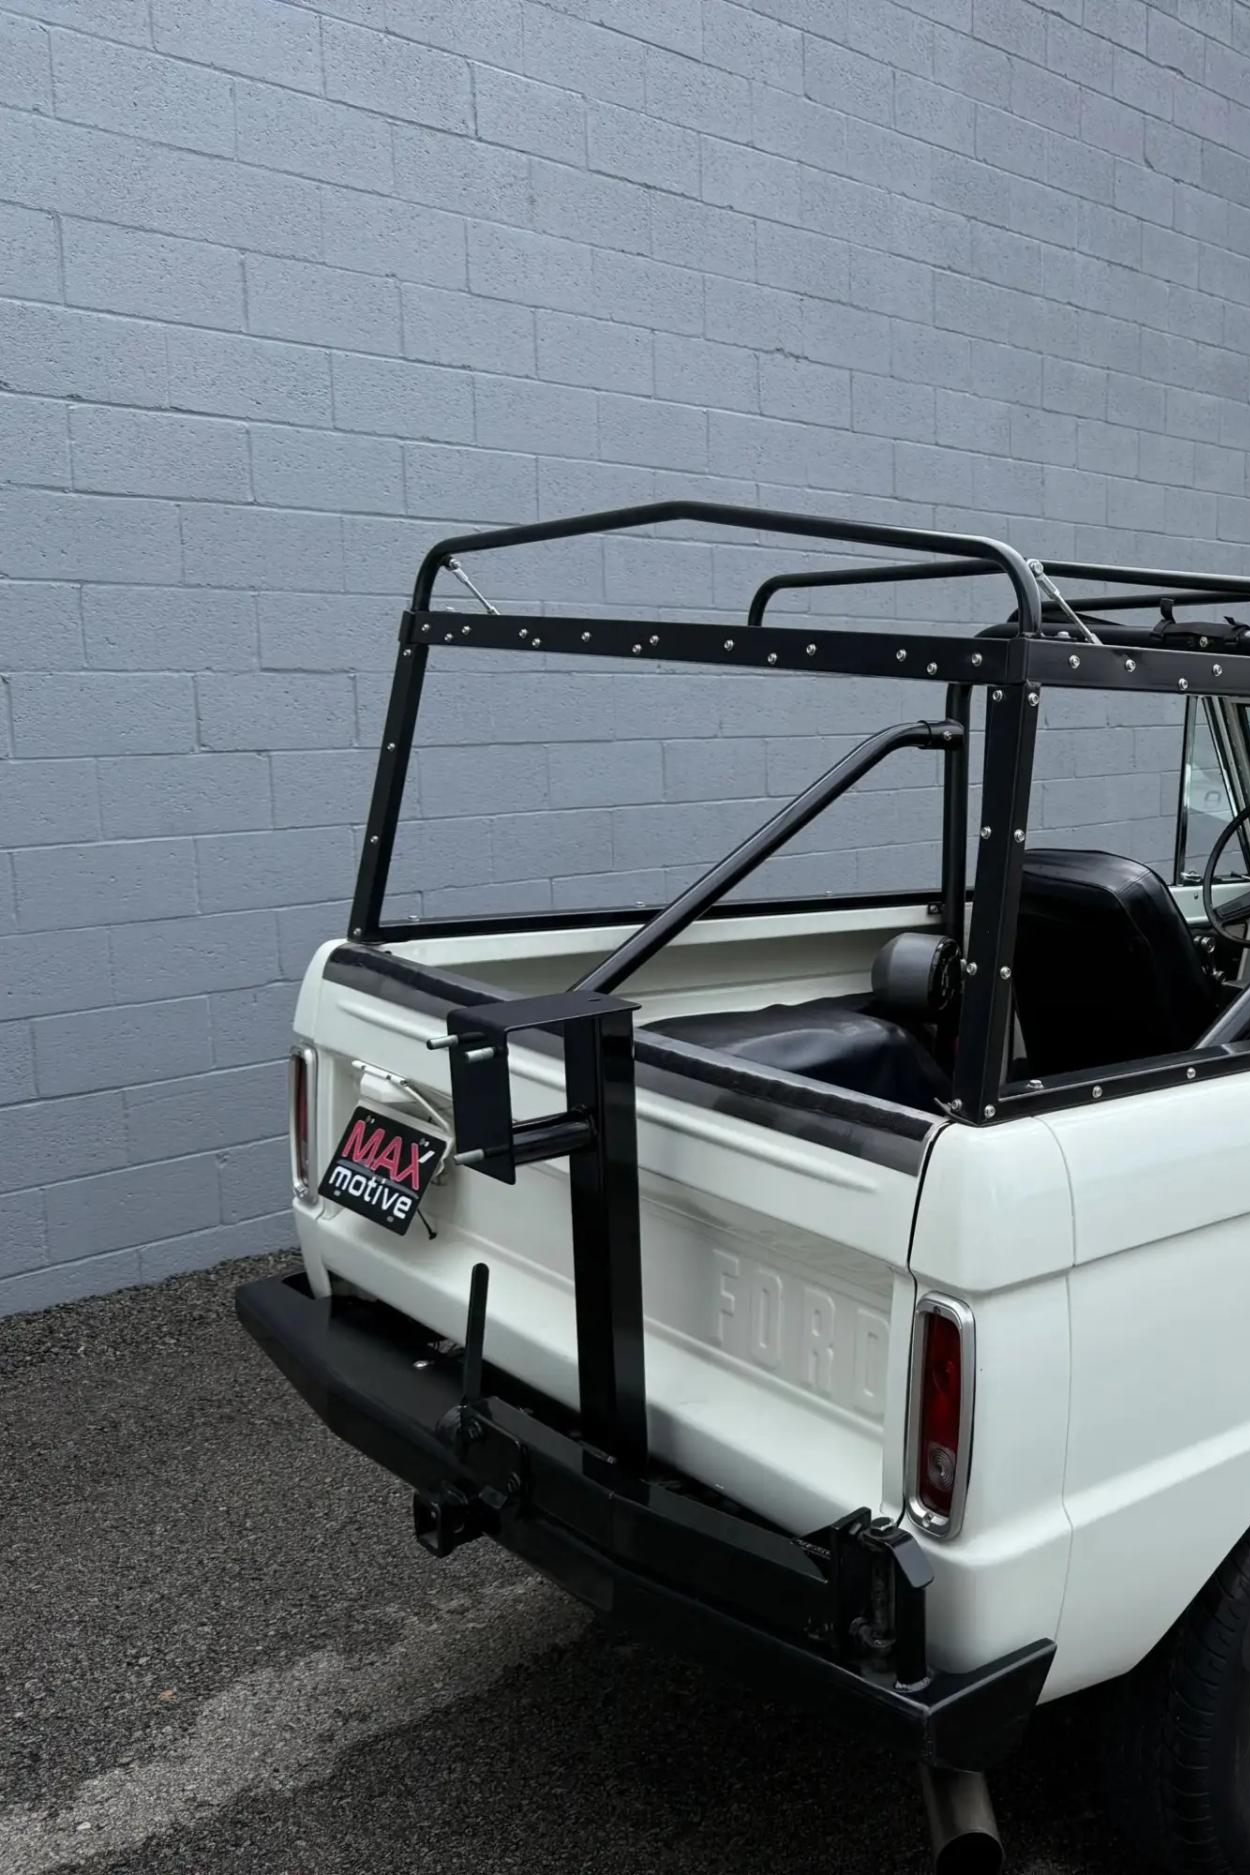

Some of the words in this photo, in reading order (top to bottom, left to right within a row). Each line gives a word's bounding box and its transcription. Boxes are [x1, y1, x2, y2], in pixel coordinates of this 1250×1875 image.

[341, 1119, 435, 1191] MAX
[328, 1165, 413, 1219] motive
[711, 1248, 890, 1416] FORD
